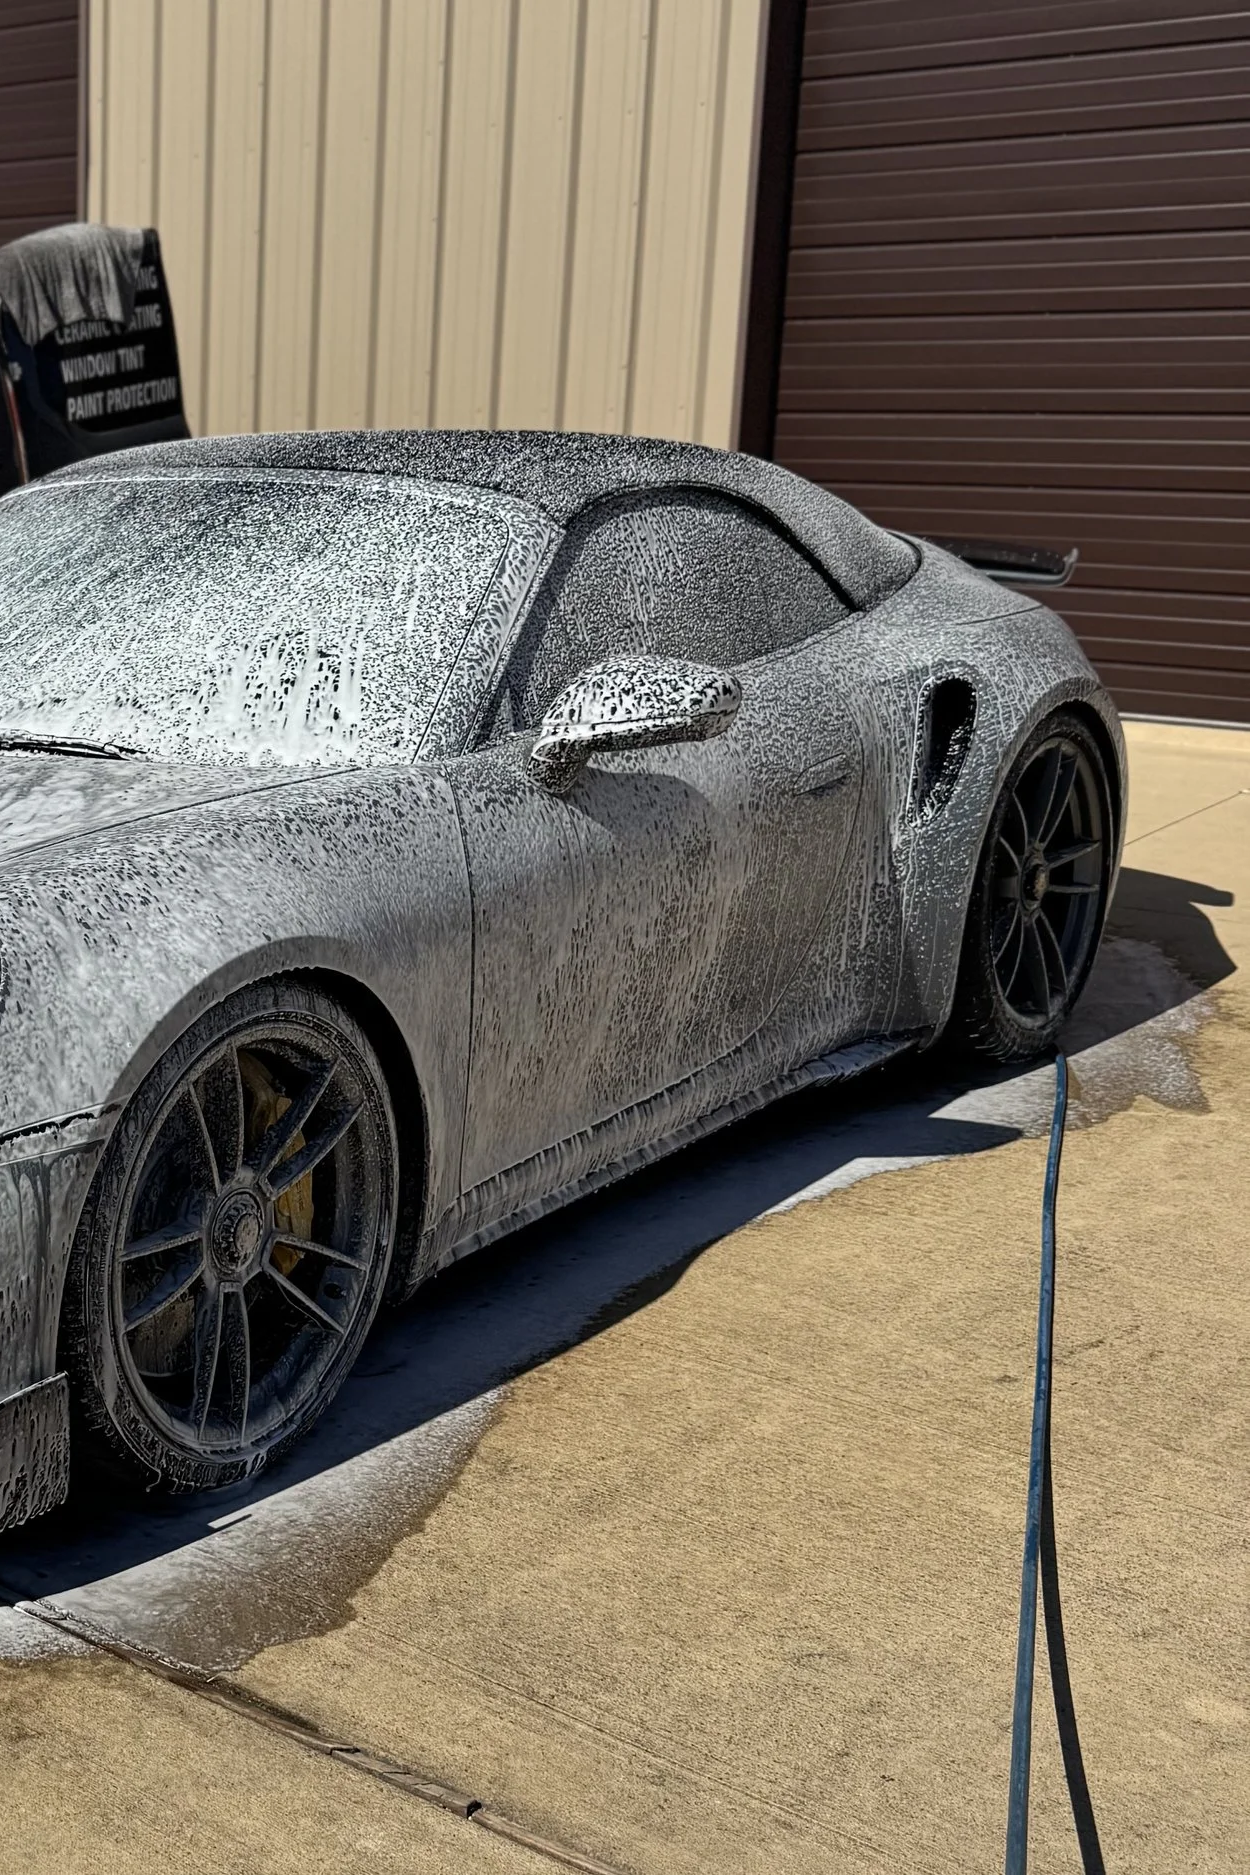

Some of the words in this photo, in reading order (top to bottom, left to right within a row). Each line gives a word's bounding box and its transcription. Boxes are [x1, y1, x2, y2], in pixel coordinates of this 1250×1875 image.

[61, 351, 116, 383] WINDOW
[117, 344, 145, 372] TINT
[67, 391, 105, 421] PAINT
[107, 377, 177, 413] PROTECTION
